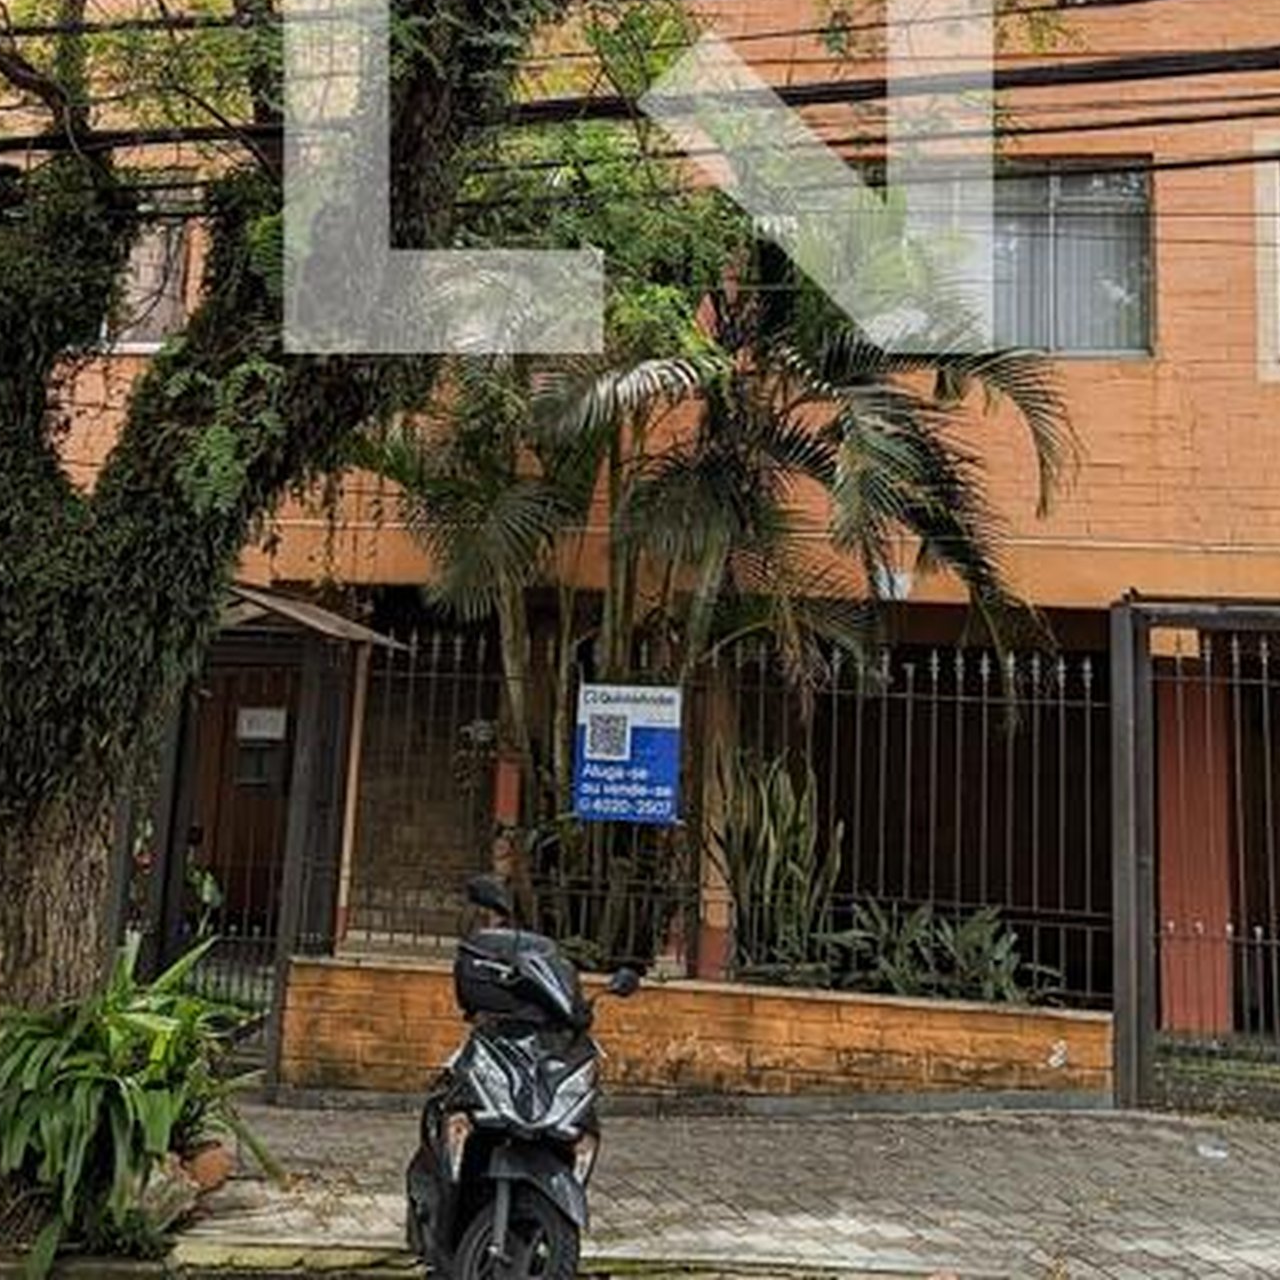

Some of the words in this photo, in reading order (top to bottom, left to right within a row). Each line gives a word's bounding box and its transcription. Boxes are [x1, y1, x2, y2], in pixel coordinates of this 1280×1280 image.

[582, 763, 648, 781] Aluga-se
[580, 783, 600, 794] ou
[603, 784, 672, 798] vende-se
